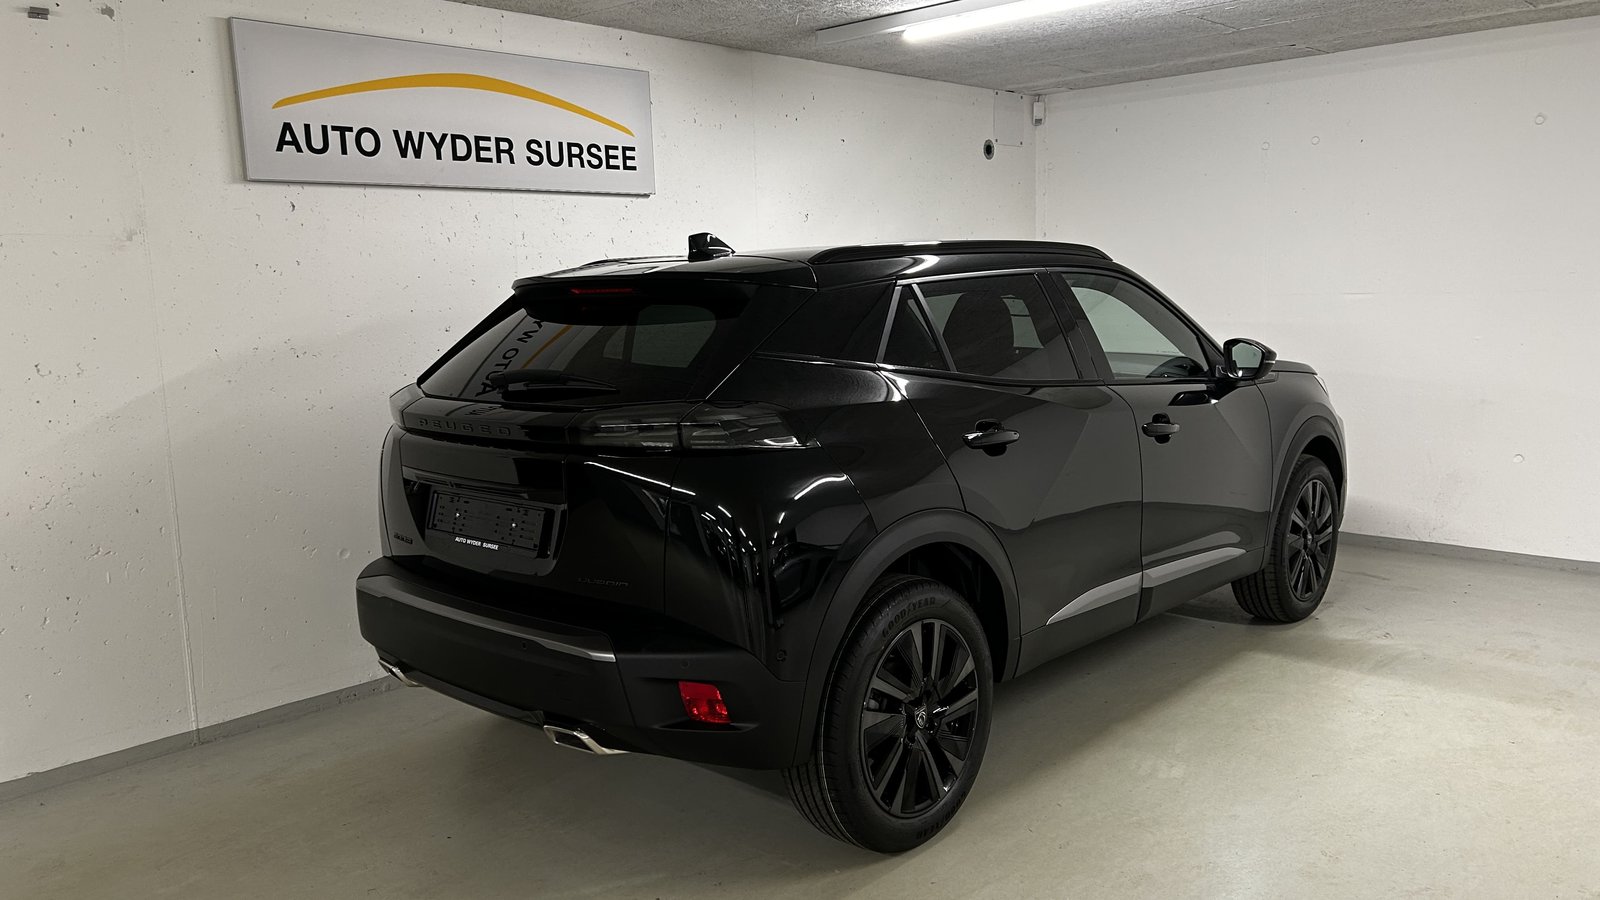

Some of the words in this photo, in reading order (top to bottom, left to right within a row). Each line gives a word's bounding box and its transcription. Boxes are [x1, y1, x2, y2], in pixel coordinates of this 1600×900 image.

[275, 121, 381, 158] AUTO
[392, 129, 516, 165] WYDER
[525, 138, 637, 171] SURSEE
[418, 417, 526, 438] PEUGEO
[454, 536, 467, 544] AUTO
[466, 538, 482, 548] WYDER
[881, 596, 936, 638] GOODYEAR
